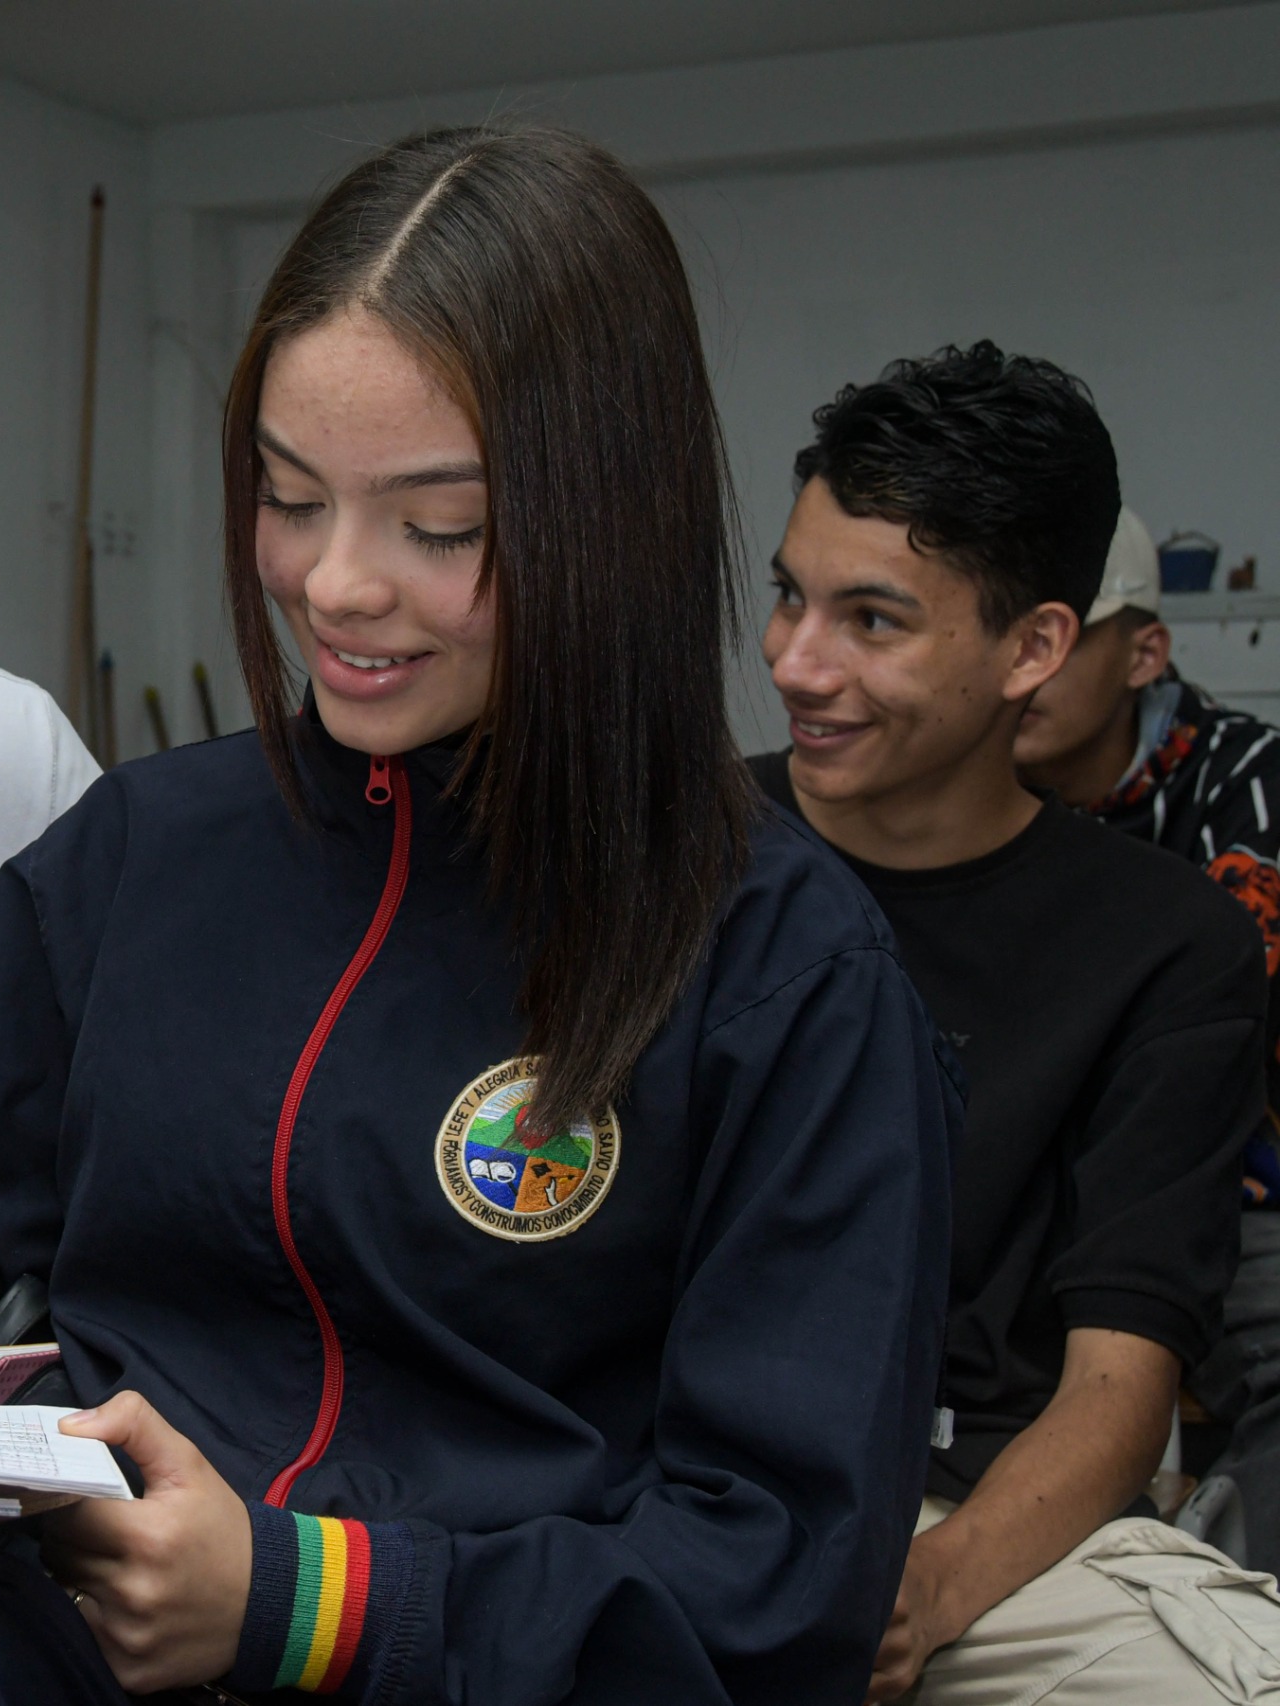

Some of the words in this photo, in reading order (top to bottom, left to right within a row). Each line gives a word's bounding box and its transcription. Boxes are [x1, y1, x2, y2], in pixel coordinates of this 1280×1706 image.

[473, 1066, 521, 1100] ALEGRIA
[442, 1140, 468, 1196] FORMAMOS
[596, 1132, 613, 1171] SAVIO
